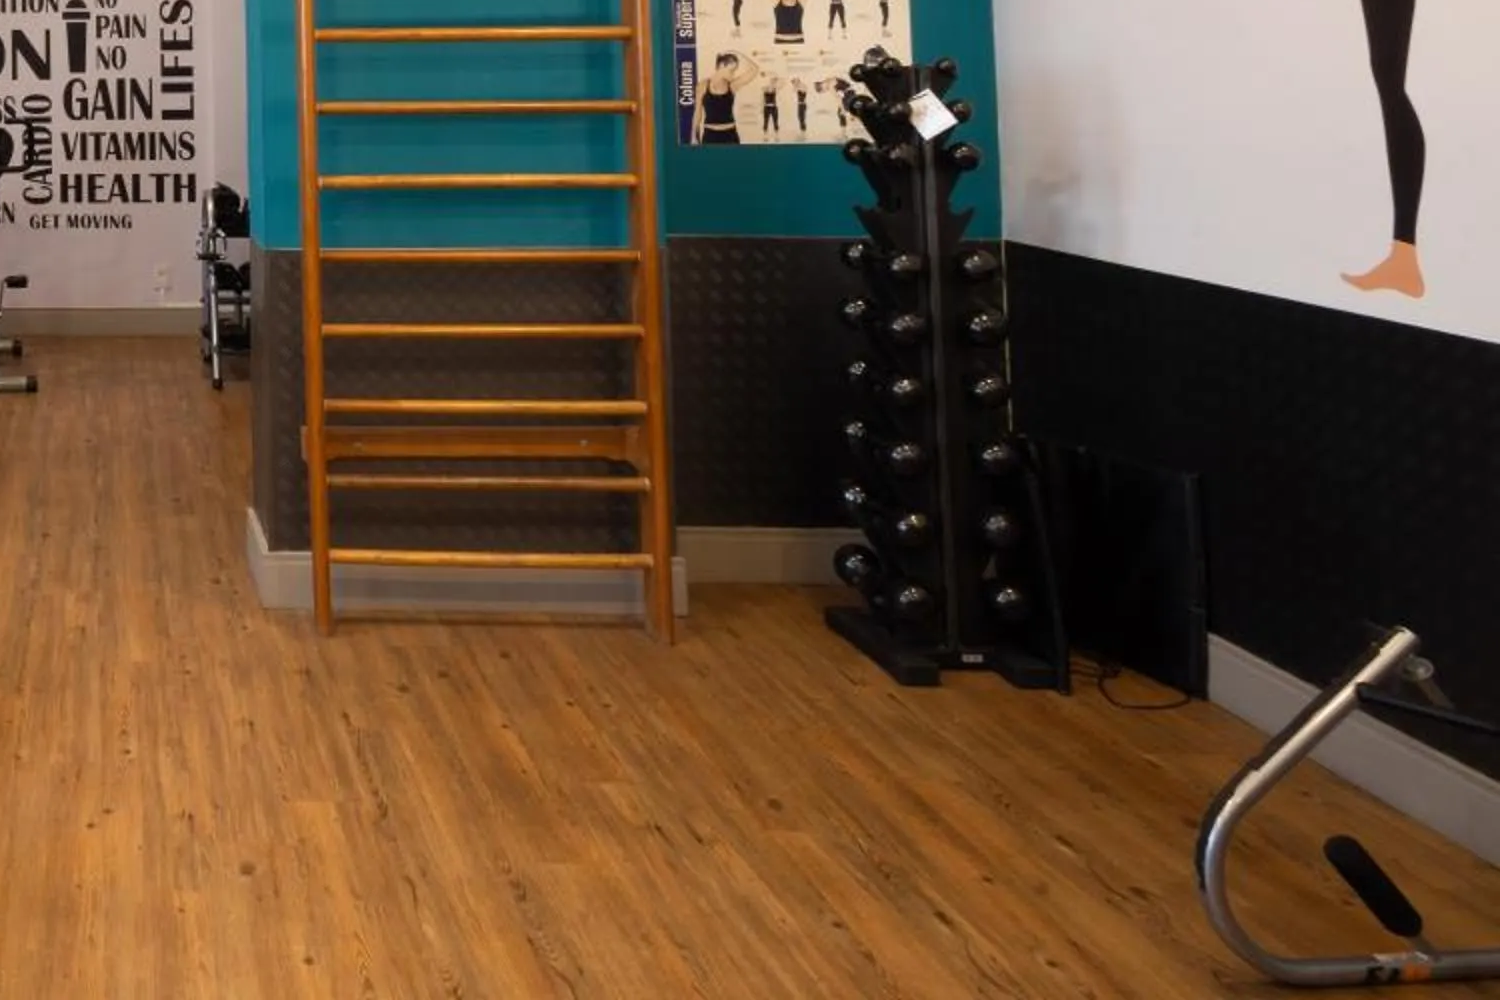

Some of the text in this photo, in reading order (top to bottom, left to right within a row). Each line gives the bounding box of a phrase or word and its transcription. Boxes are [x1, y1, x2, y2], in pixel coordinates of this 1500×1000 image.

[95, 14, 147, 39] PAIN
[96, 46, 127, 70] NO
[678, 61, 693, 106] Coluna
[62, 78, 153, 121] GAIN
[22, 94, 53, 204] CARDIO
[60, 131, 196, 161] VITAMINS
[59, 173, 197, 203] HEALTH
[29, 214, 133, 230] GET MOVING
